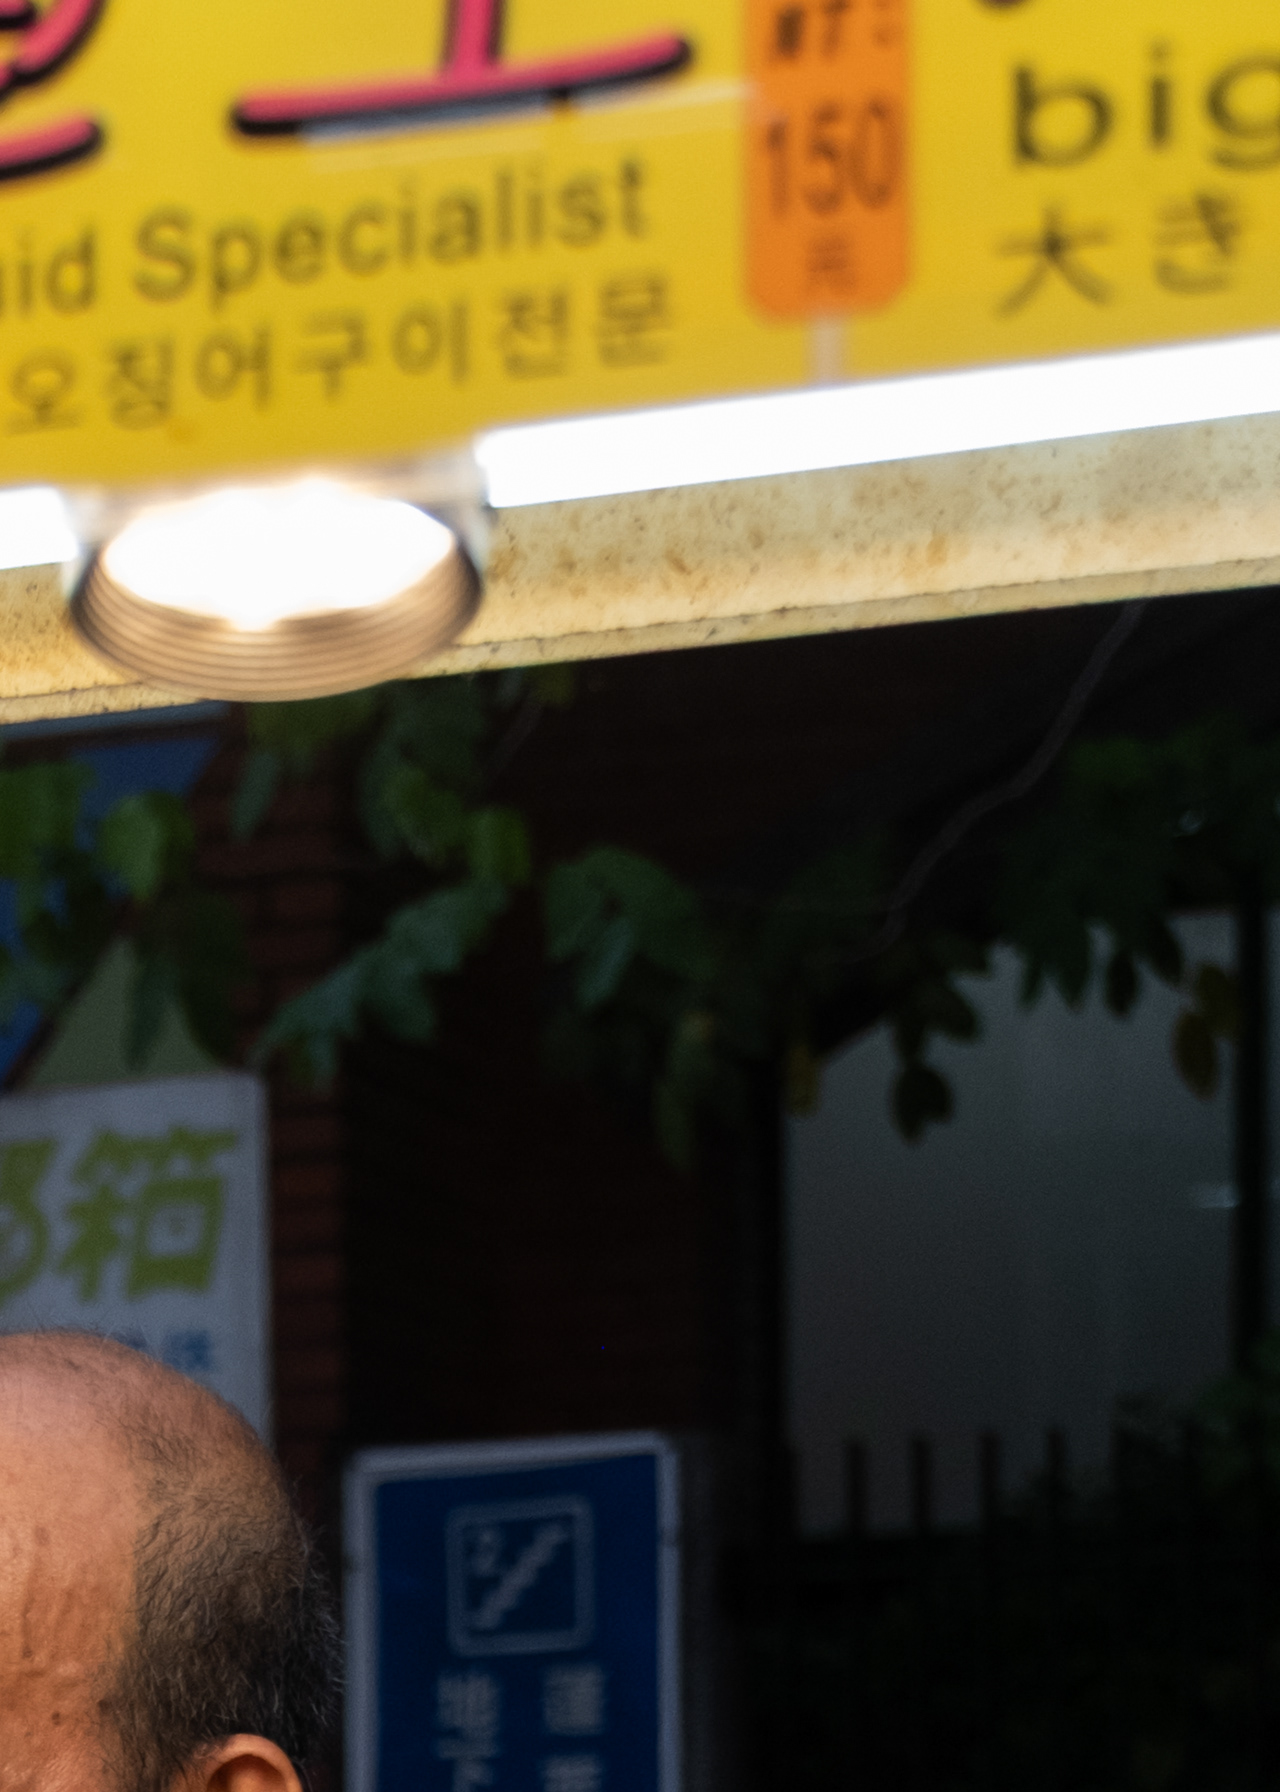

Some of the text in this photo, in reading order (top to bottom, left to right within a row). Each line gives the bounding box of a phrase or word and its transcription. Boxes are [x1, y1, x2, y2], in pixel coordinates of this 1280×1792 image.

[132, 155, 652, 318] Specialist
[762, 92, 906, 220] 150
[3, 268, 676, 438] 오징어구이전문
